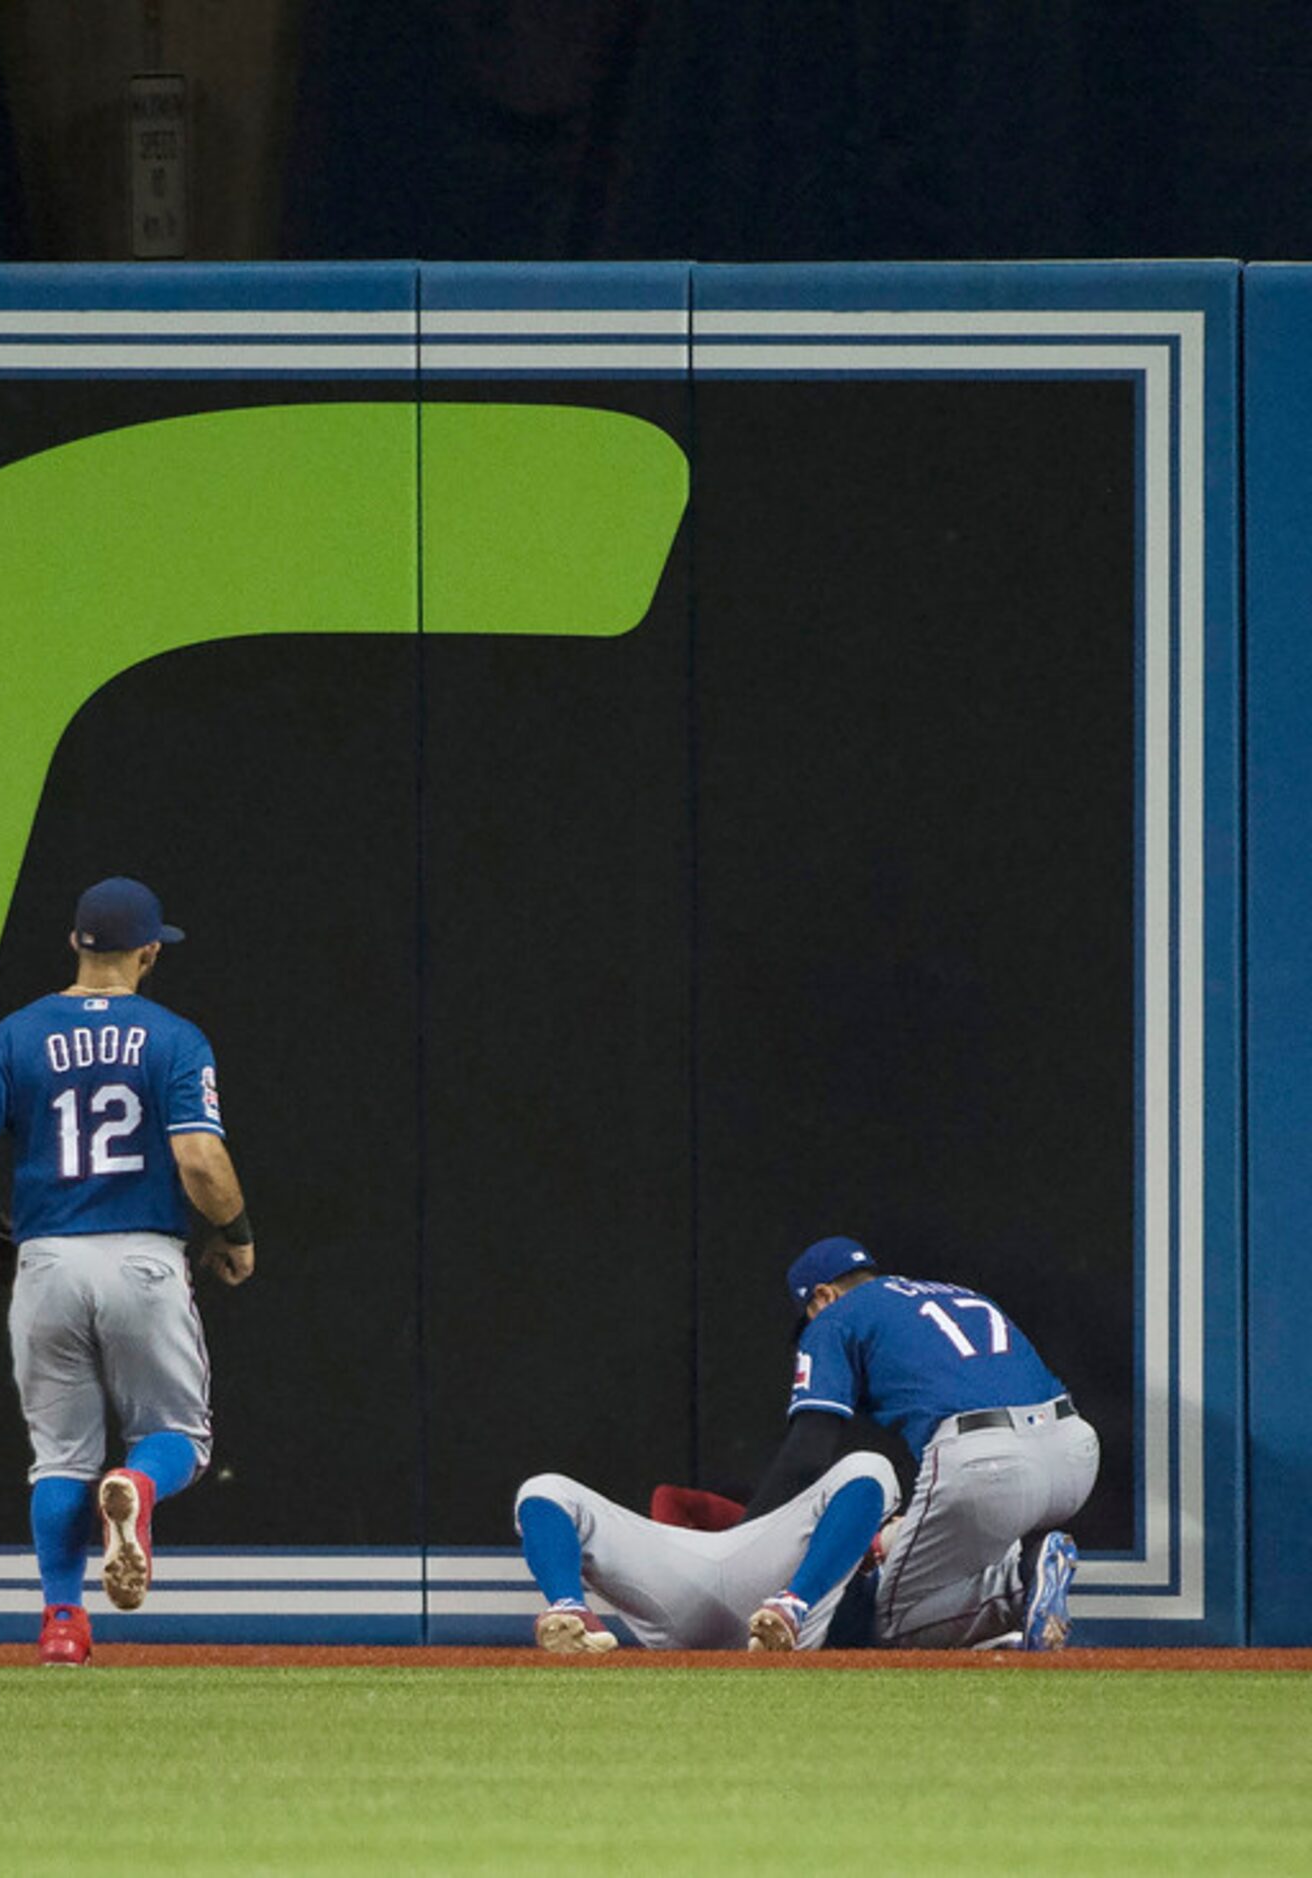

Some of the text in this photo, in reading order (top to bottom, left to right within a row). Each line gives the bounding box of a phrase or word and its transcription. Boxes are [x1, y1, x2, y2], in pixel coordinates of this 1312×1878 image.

[46, 1025, 147, 1073] ODOR
[52, 1083, 146, 1179] 12
[918, 1298, 1010, 1358] 17
